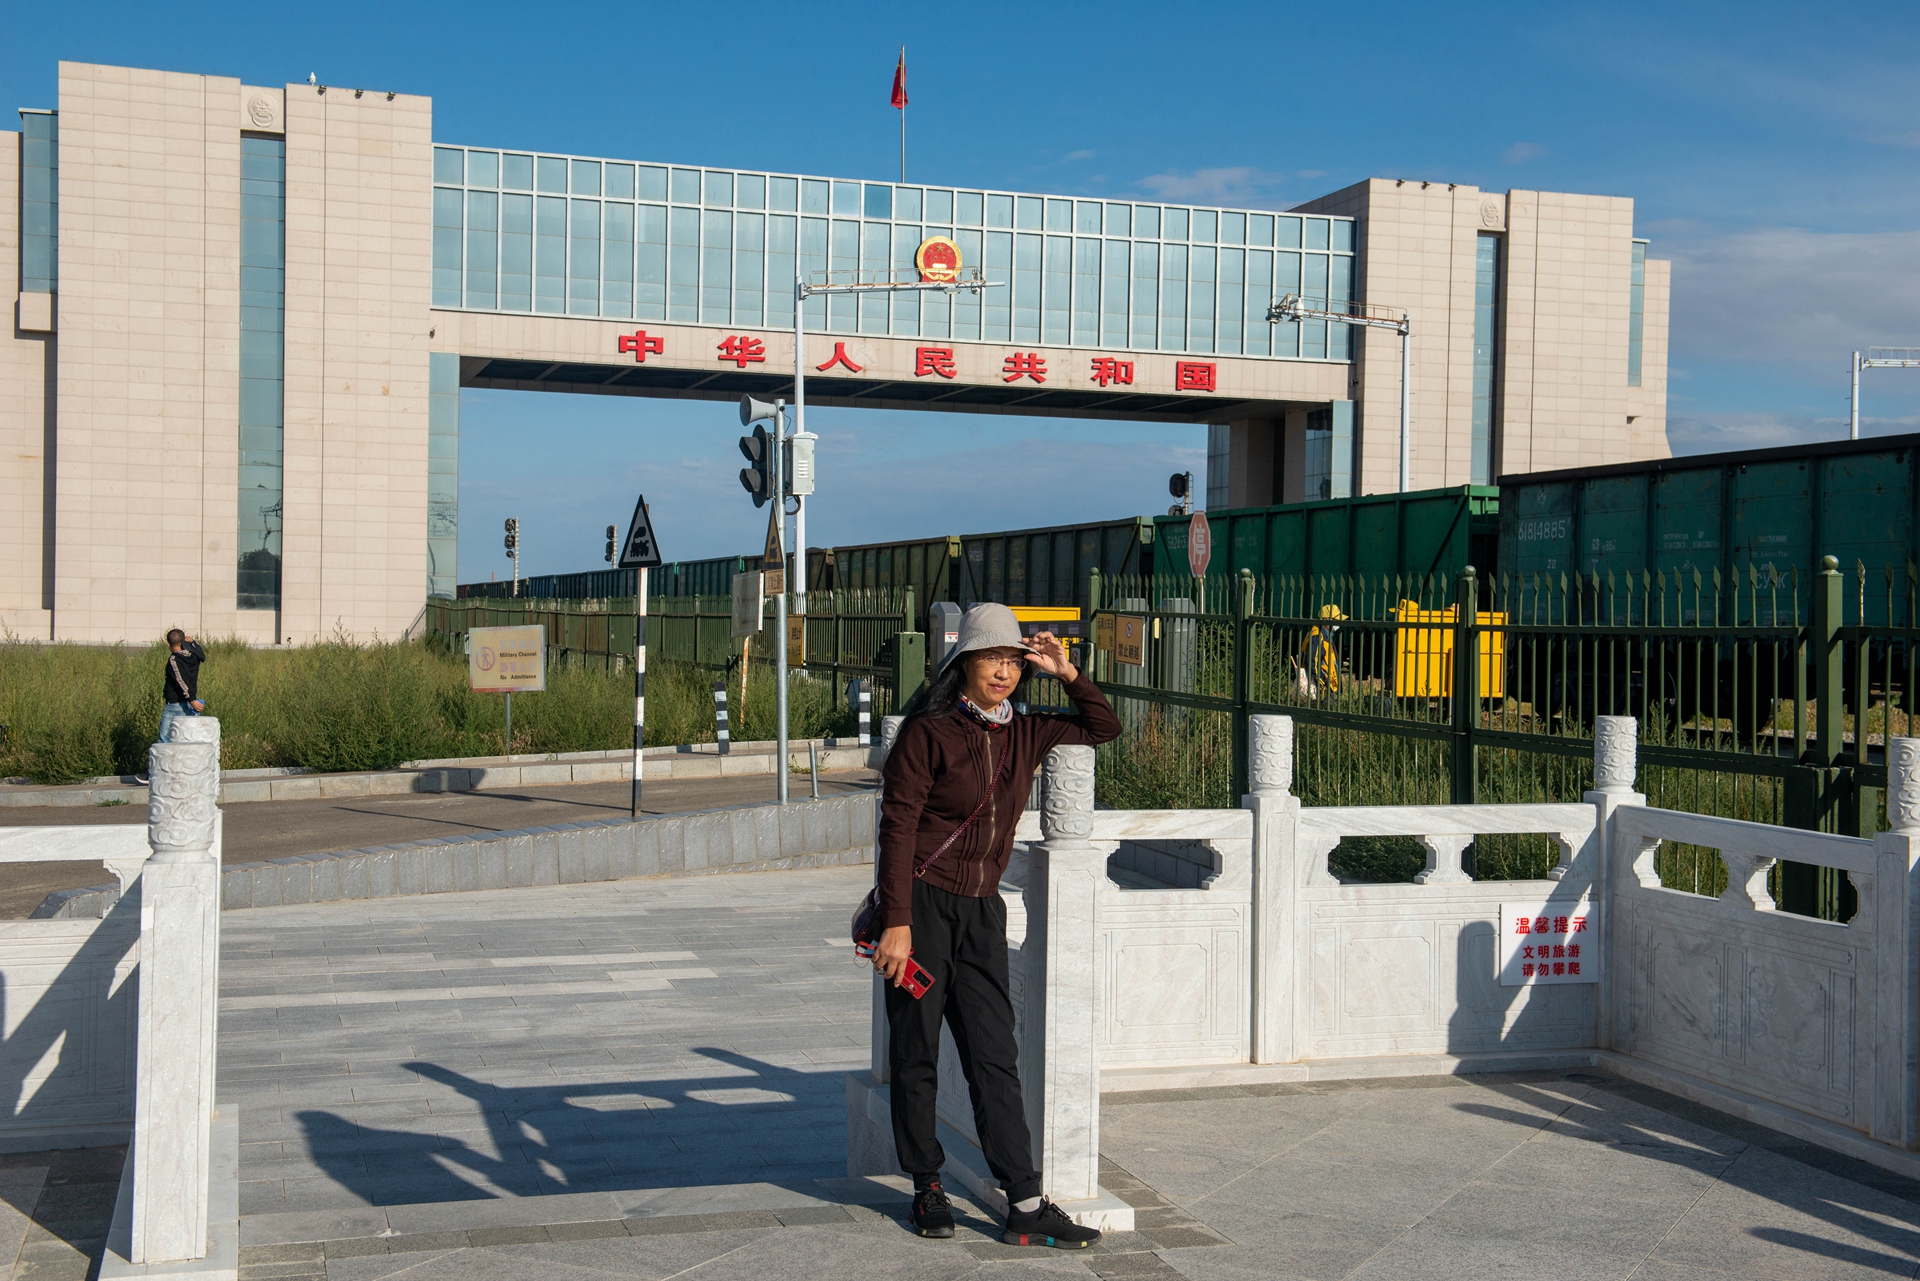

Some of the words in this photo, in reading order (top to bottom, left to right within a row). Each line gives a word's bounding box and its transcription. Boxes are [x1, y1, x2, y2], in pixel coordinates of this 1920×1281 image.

[618, 330, 1217, 392] 中华人民共和国
[1518, 520, 1565, 541] 61814885
[1192, 522, 1206, 566] 停
[1547, 559, 1557, 569] 20
[1756, 572, 1788, 590] СУК
[1118, 643, 1139, 660] 禁止翻越
[1515, 916, 1587, 934] 温馨提示
[1522, 944, 1580, 959] 文明旅游
[1522, 962, 1581, 977] 请勿攀爬
